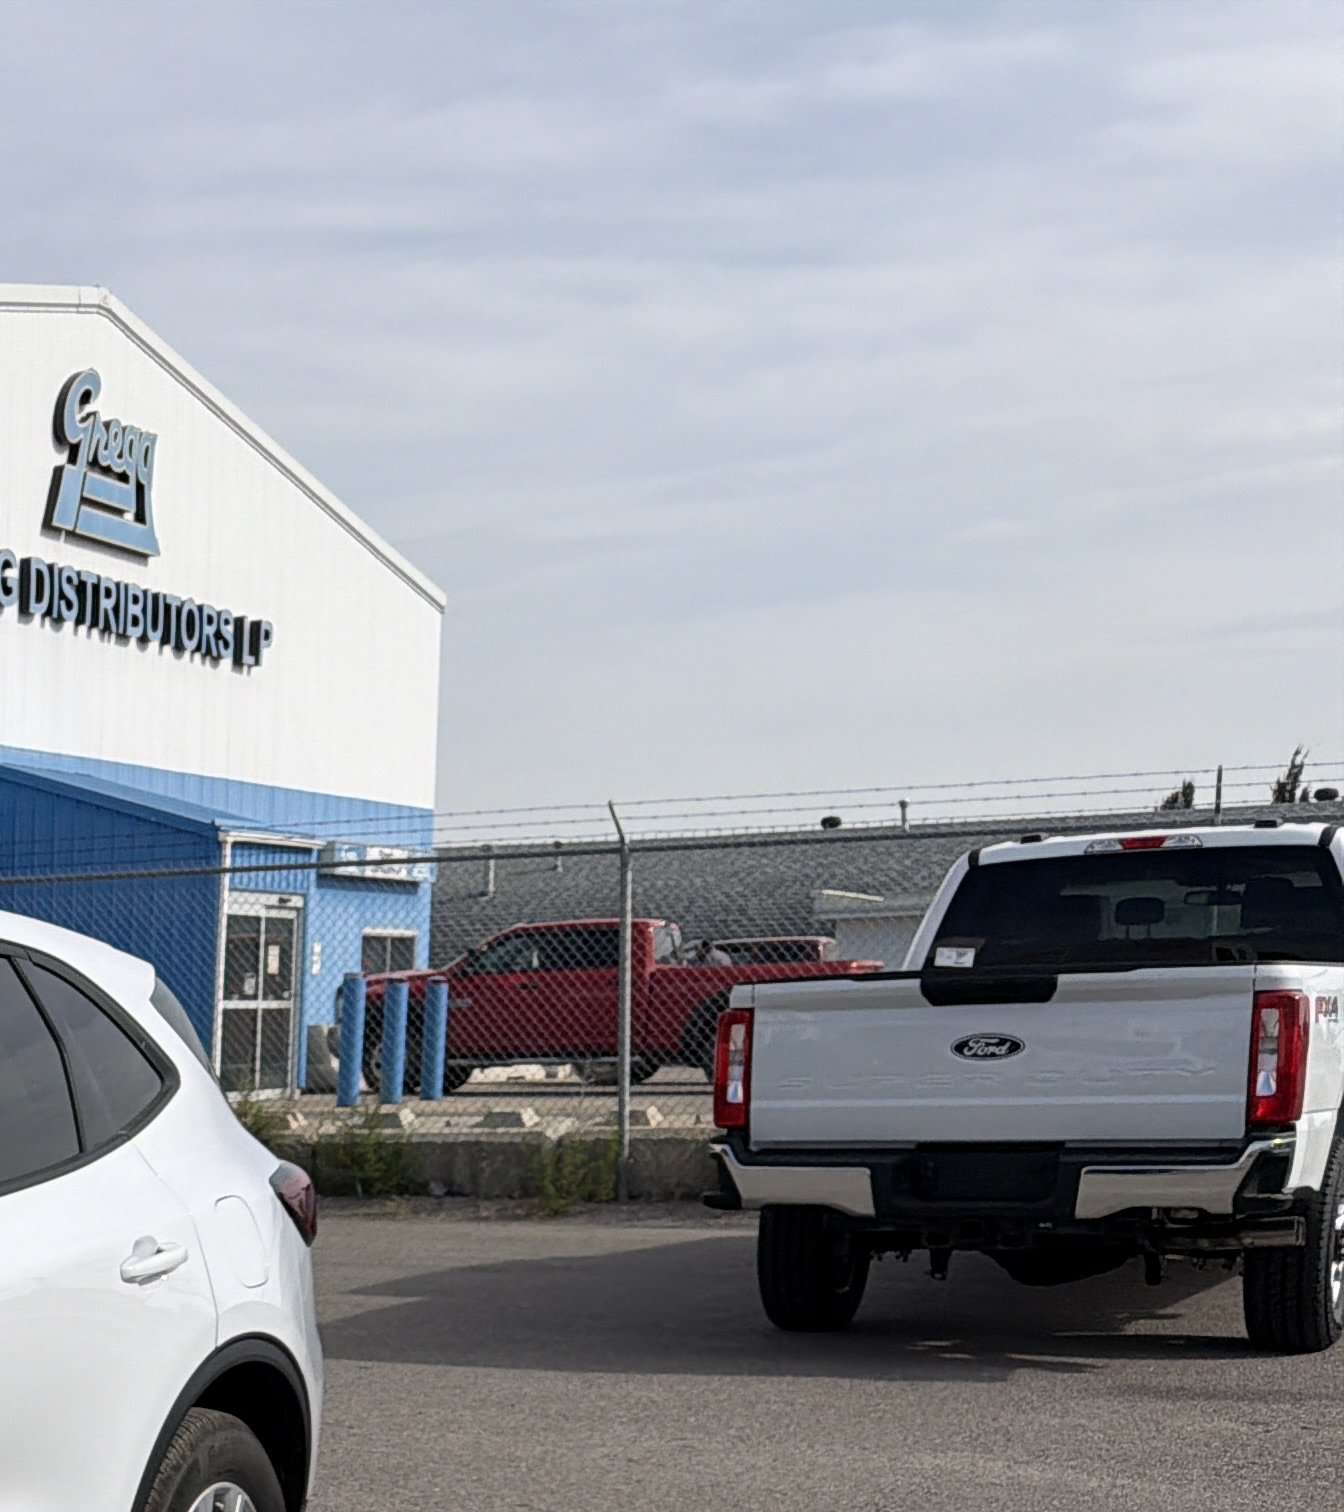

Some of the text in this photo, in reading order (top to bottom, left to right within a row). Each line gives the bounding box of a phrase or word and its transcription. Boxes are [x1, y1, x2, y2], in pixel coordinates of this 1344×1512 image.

[52, 368, 159, 518] Gregg
[22, 556, 235, 660] DISTRIBUTORS
[962, 1037, 1013, 1057] Ford
